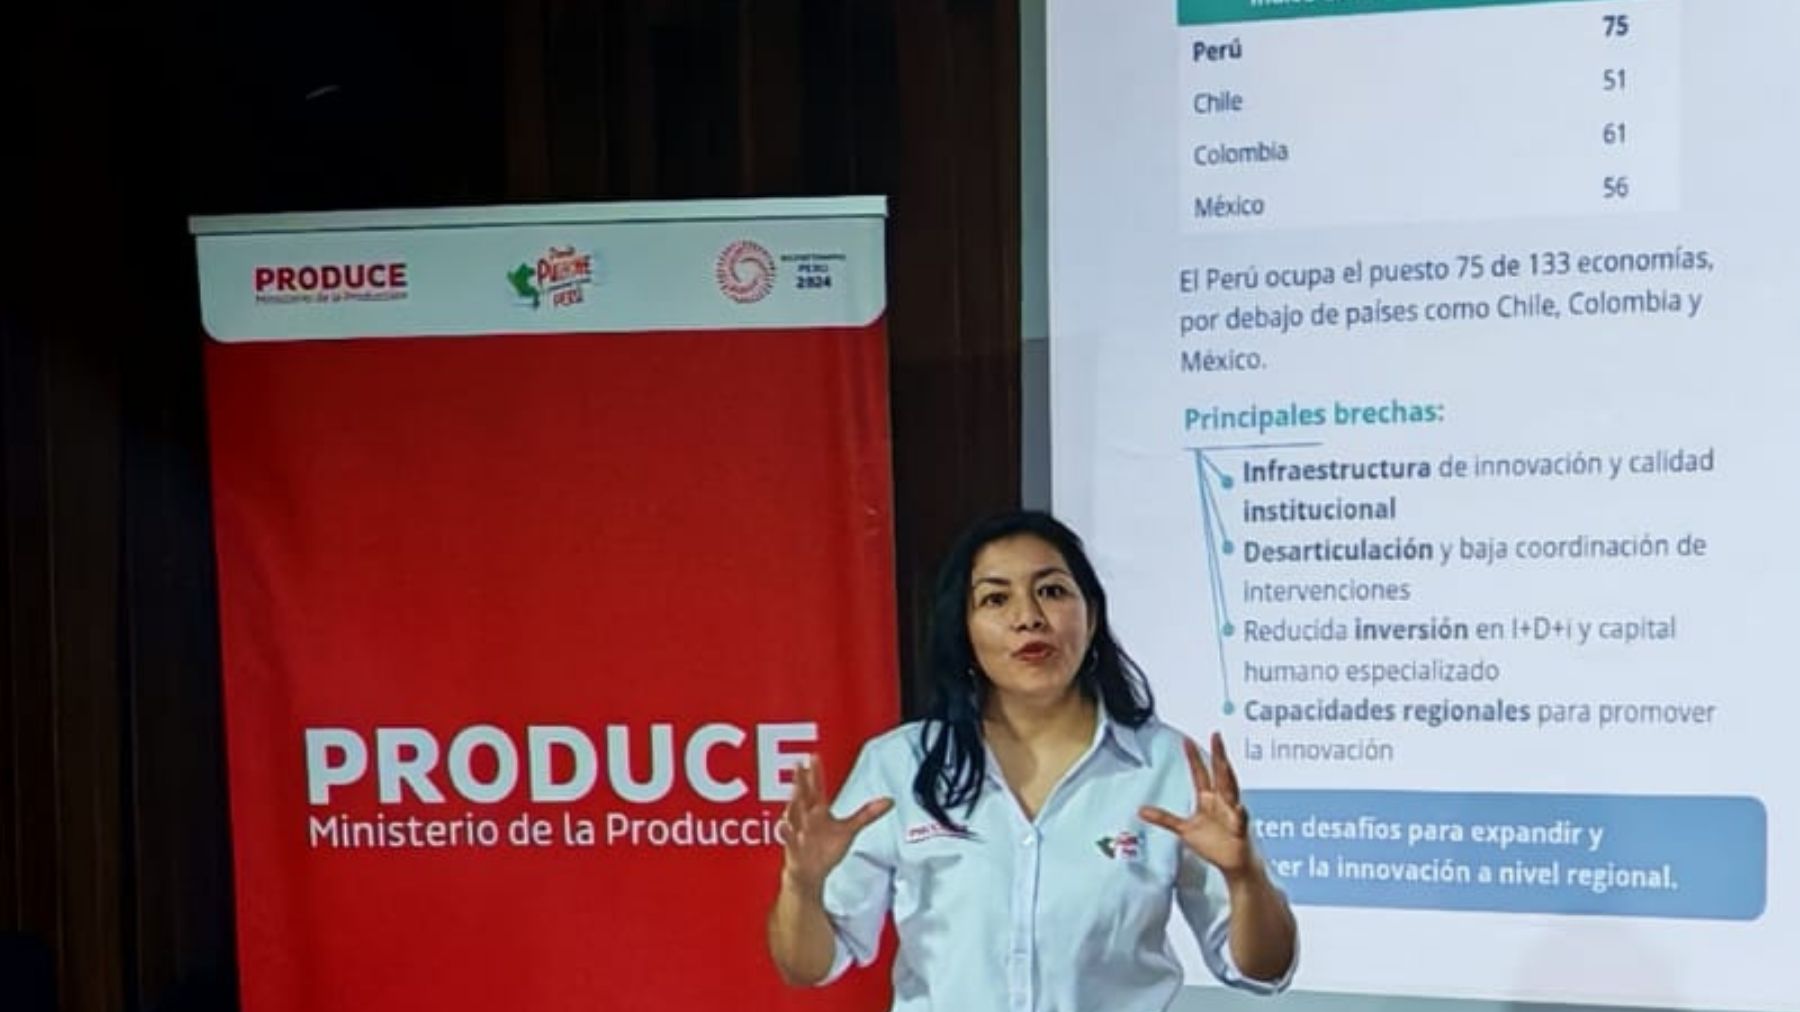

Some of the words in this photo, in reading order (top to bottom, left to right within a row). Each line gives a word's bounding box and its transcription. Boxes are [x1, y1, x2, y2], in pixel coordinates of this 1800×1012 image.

[1192, 37, 1243, 63] Perú
[1602, 14, 1629, 38] 75
[1193, 90, 1244, 115] Chile
[1603, 68, 1626, 91] 51
[1193, 141, 1289, 167] Colombia
[1602, 122, 1626, 145] 61
[1194, 194, 1265, 219] México
[1603, 176, 1629, 199] 56
[255, 262, 408, 292] PRODUCE
[1179, 268, 1199, 293] El
[1206, 265, 1259, 291] Perú
[1264, 266, 1336, 292] ocupa
[1369, 260, 1450, 289] puesto
[1455, 254, 1485, 280] 75
[1490, 253, 1521, 278] de
[1529, 251, 1571, 276] 133
[1576, 245, 1714, 275] economías,
[1180, 312, 1220, 338] por
[1225, 304, 1304, 334] debajo
[1310, 302, 1340, 327] de
[1345, 298, 1419, 331] países
[1424, 301, 1491, 322] como
[1496, 293, 1561, 319] Chile,
[1568, 288, 1682, 316] Colombia
[1180, 349, 1266, 373] México.
[1184, 402, 1327, 436] Principales
[1334, 399, 1445, 426] brechas:
[1243, 458, 1432, 483] Infraestructura
[1437, 454, 1468, 478] de
[1474, 450, 1603, 477] innovación
[1628, 446, 1715, 474] calidad
[1243, 496, 1396, 523] institucional
[1243, 536, 1434, 564] Desarticulación
[1459, 536, 1509, 566] baja
[1515, 533, 1669, 559] coordinación
[1676, 533, 1707, 557] de
[1243, 578, 1411, 603] intervenciones
[1243, 617, 1348, 643] Reducida
[1354, 617, 1469, 641] inversión
[1598, 615, 1676, 644] capital
[1243, 660, 1340, 683] humano
[1345, 658, 1500, 688] especializado
[1243, 697, 1396, 728] Capacidades
[1403, 698, 1531, 728] regionales
[1537, 703, 1591, 729] para
[1598, 703, 1717, 730] promover
[305, 722, 819, 805] PRODUCE
[1270, 737, 1394, 762] innovación
[310, 814, 498, 847] Ministerio
[509, 815, 552, 845] de
[565, 813, 594, 845] la
[1407, 823, 1464, 847] para
[1470, 819, 1583, 850] expandir
[1337, 855, 1471, 883] innovación
[1499, 860, 1560, 885] nivel
[1567, 862, 1678, 894] regional.
